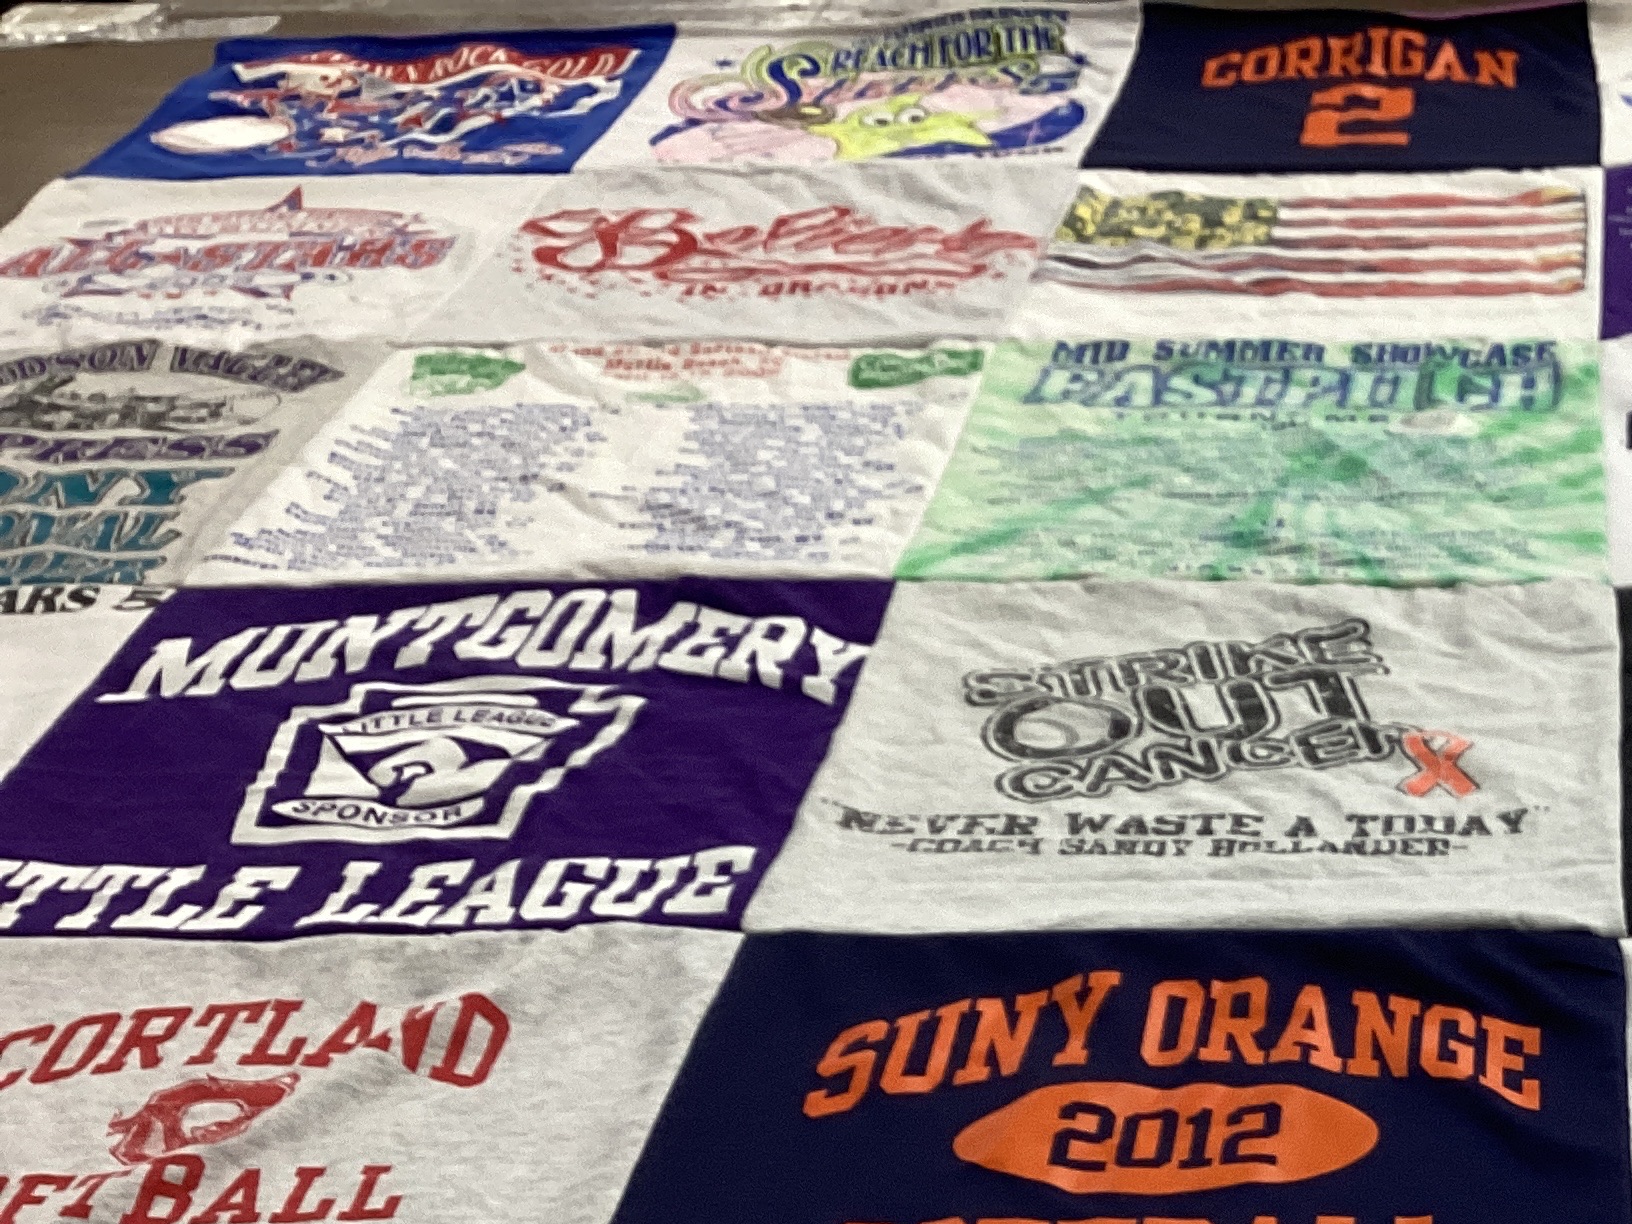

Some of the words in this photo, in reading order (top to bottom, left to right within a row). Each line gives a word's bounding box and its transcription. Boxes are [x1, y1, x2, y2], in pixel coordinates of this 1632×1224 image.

[1202, 26, 1520, 89] CORRIGAN
[1300, 82, 1416, 147] 2
[1050, 340, 1131, 364] MID
[1154, 338, 1325, 363] SUMMER
[1351, 340, 1558, 369] SHOWCASE
[95, 588, 872, 705] MONTGOMERY
[963, 617, 1390, 705] STRIKE
[982, 668, 1374, 764] OUT
[292, 800, 463, 825] SPONSOR
[1057, 836, 1194, 857] SANDY
[1065, 811, 1265, 838] WASTE
[1284, 814, 1320, 838] A
[294, 846, 759, 930] LEAGUE
[802, 969, 1122, 1119] SUNY
[1140, 975, 1542, 1111] ORANGE
[1046, 1100, 1283, 1172] 2012
